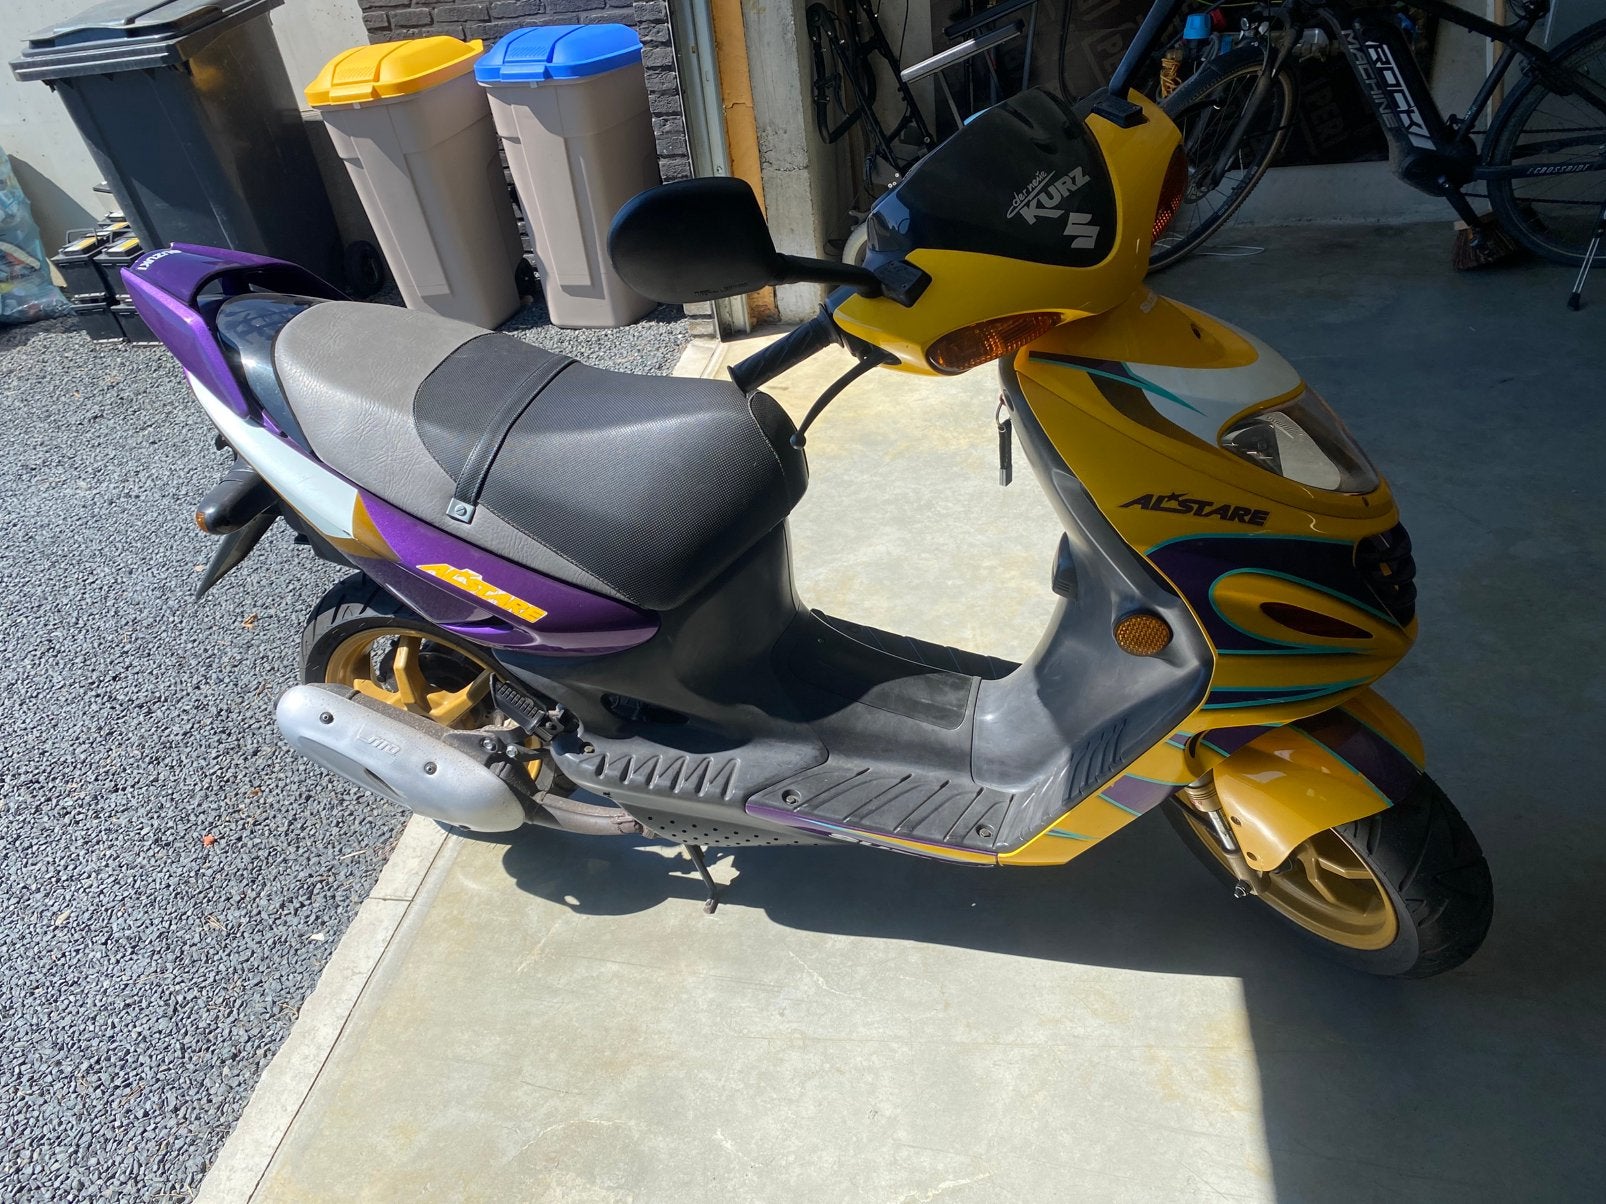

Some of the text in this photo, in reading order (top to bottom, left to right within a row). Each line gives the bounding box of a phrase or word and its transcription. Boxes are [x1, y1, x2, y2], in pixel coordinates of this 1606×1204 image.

[1341, 28, 1398, 128] MACHINE
[1365, 41, 1432, 138] ROCK
[1019, 166, 1091, 225] KURZ
[1117, 492, 1271, 527] ALSTARE
